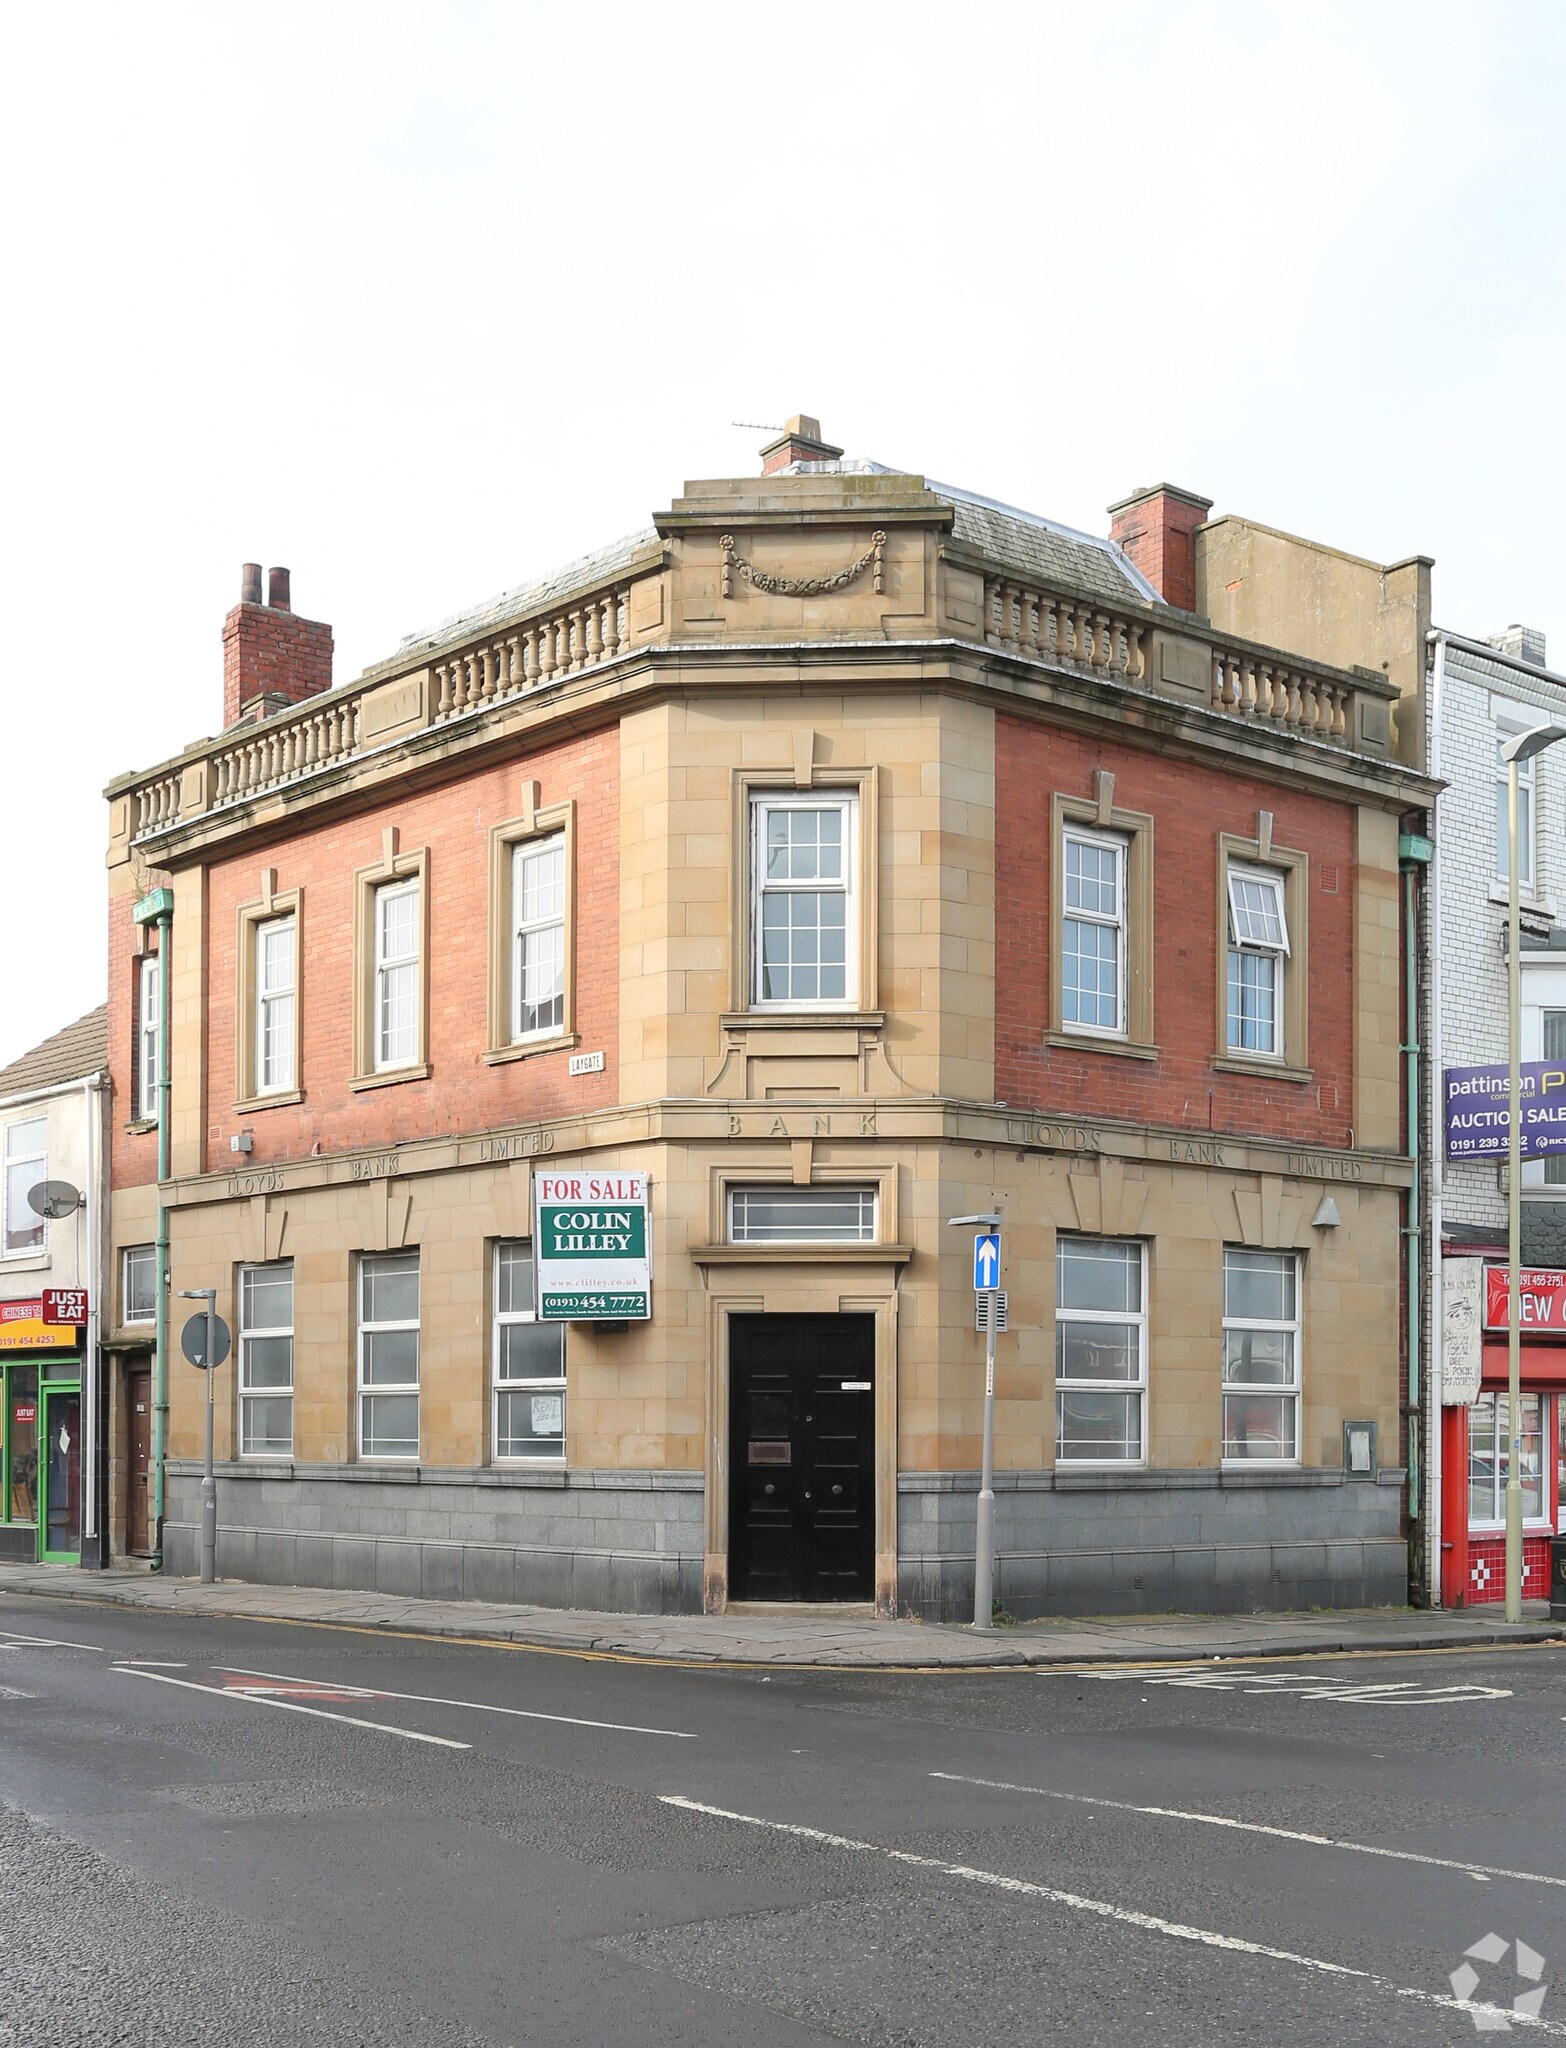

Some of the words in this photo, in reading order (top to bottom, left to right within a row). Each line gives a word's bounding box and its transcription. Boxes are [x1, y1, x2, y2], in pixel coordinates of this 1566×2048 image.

[572, 1058, 601, 1072] LAYGATE
[1490, 1090, 1536, 1101] comrcial
[1527, 1106, 1566, 1124] SALE
[727, 1113, 879, 1136] BANK
[1005, 1120, 1101, 1151] LLOYDS
[1170, 1140, 1226, 1166] BANK
[1288, 1154, 1364, 1181] LIMITED
[1450, 1138, 1476, 1151] 0191
[1479, 1137, 1499, 1149] 239
[1501, 1135, 1529, 1147] 32
[227, 1172, 284, 1197] LLOYDS
[353, 1154, 399, 1180] BANK
[480, 1131, 555, 1161] LIMITED
[542, 1179, 582, 1200] FOR
[589, 1179, 642, 1200] SALE
[553, 1212, 633, 1230] COLIN
[553, 1233, 633, 1252] LILLEY
[550, 1278, 639, 1288] www.clilley.co.uk
[1532, 1275, 1546, 1287] 455
[1547, 1275, 1564, 1287] 2751
[48, 1292, 85, 1305] JUST
[545, 1297, 579, 1308] (0191)
[580, 1295, 606, 1309] 454
[609, 1295, 645, 1308] 7772
[2, 1305, 33, 1320] CHINESE
[57, 1305, 85, 1318] EAT
[19, 1336, 34, 1345] 454
[35, 1335, 56, 1344] 4253
[16, 1408, 26, 1417] JUST
[26, 1408, 35, 1417] EAT
[532, 1399, 559, 1414] RENT
[1036, 1667, 1514, 1705] AHEAD
